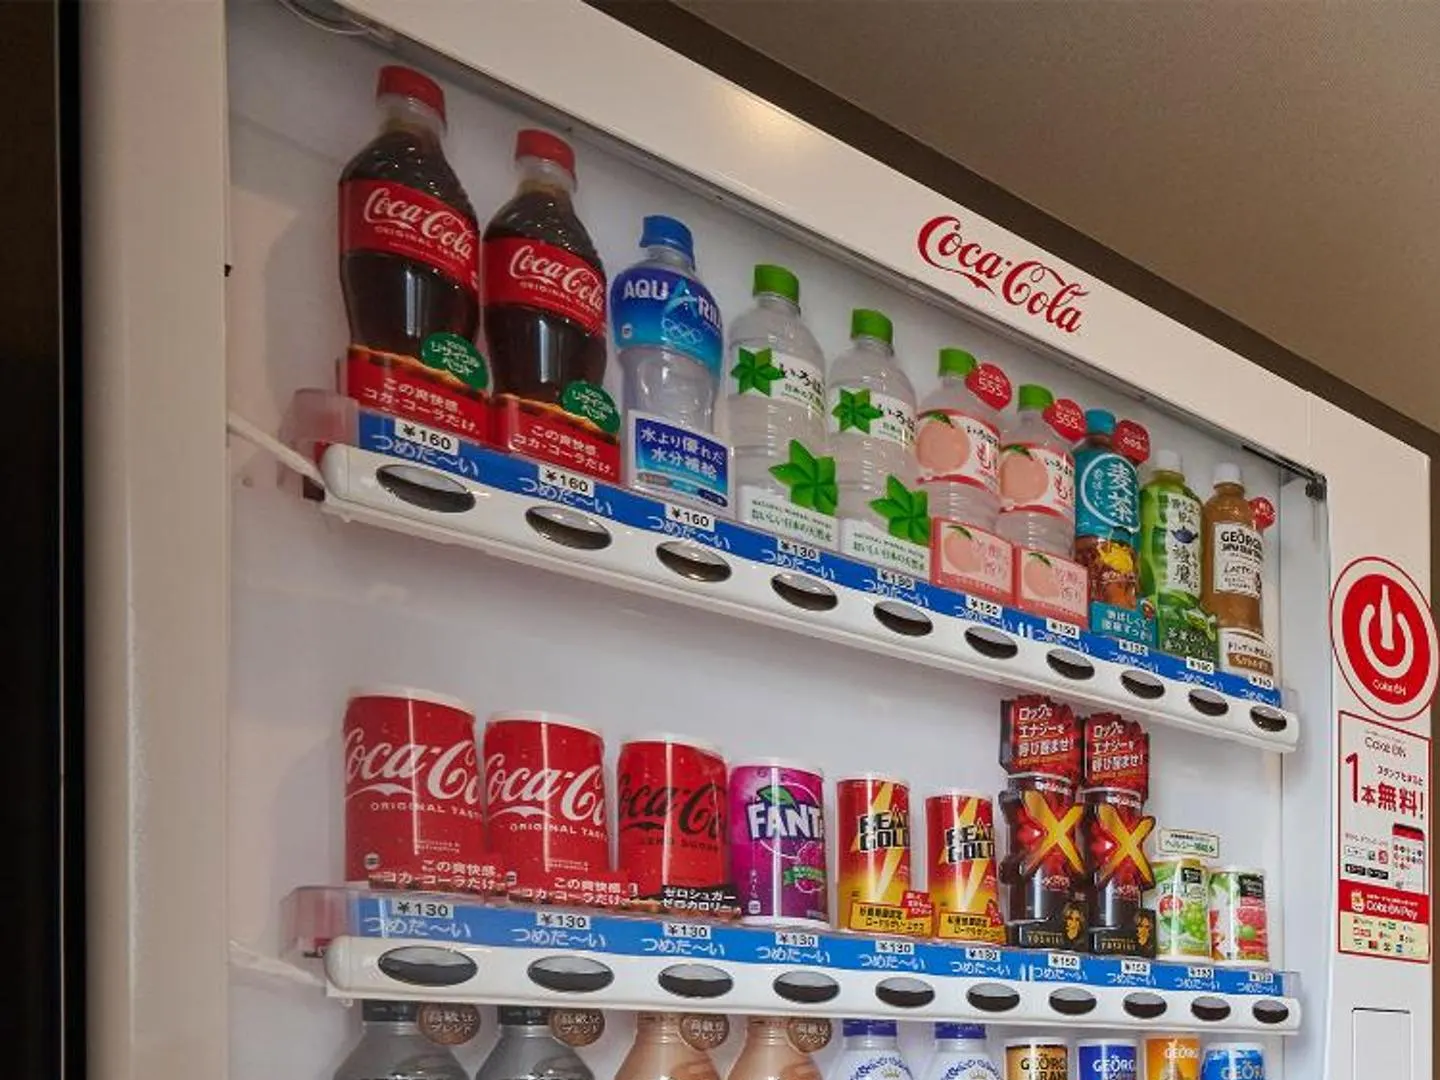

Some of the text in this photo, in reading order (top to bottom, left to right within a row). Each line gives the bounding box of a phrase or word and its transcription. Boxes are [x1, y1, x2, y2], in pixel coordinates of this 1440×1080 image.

[918, 215, 1090, 333] Coca-Cola
[403, 423, 451, 450] ¥160
[545, 470, 589, 494] ¥160
[671, 506, 710, 527] ¥160
[747, 802, 824, 839] FANT
[397, 903, 448, 917] ¥130
[541, 914, 586, 928] ¥130
[668, 924, 708, 938] ¥130
